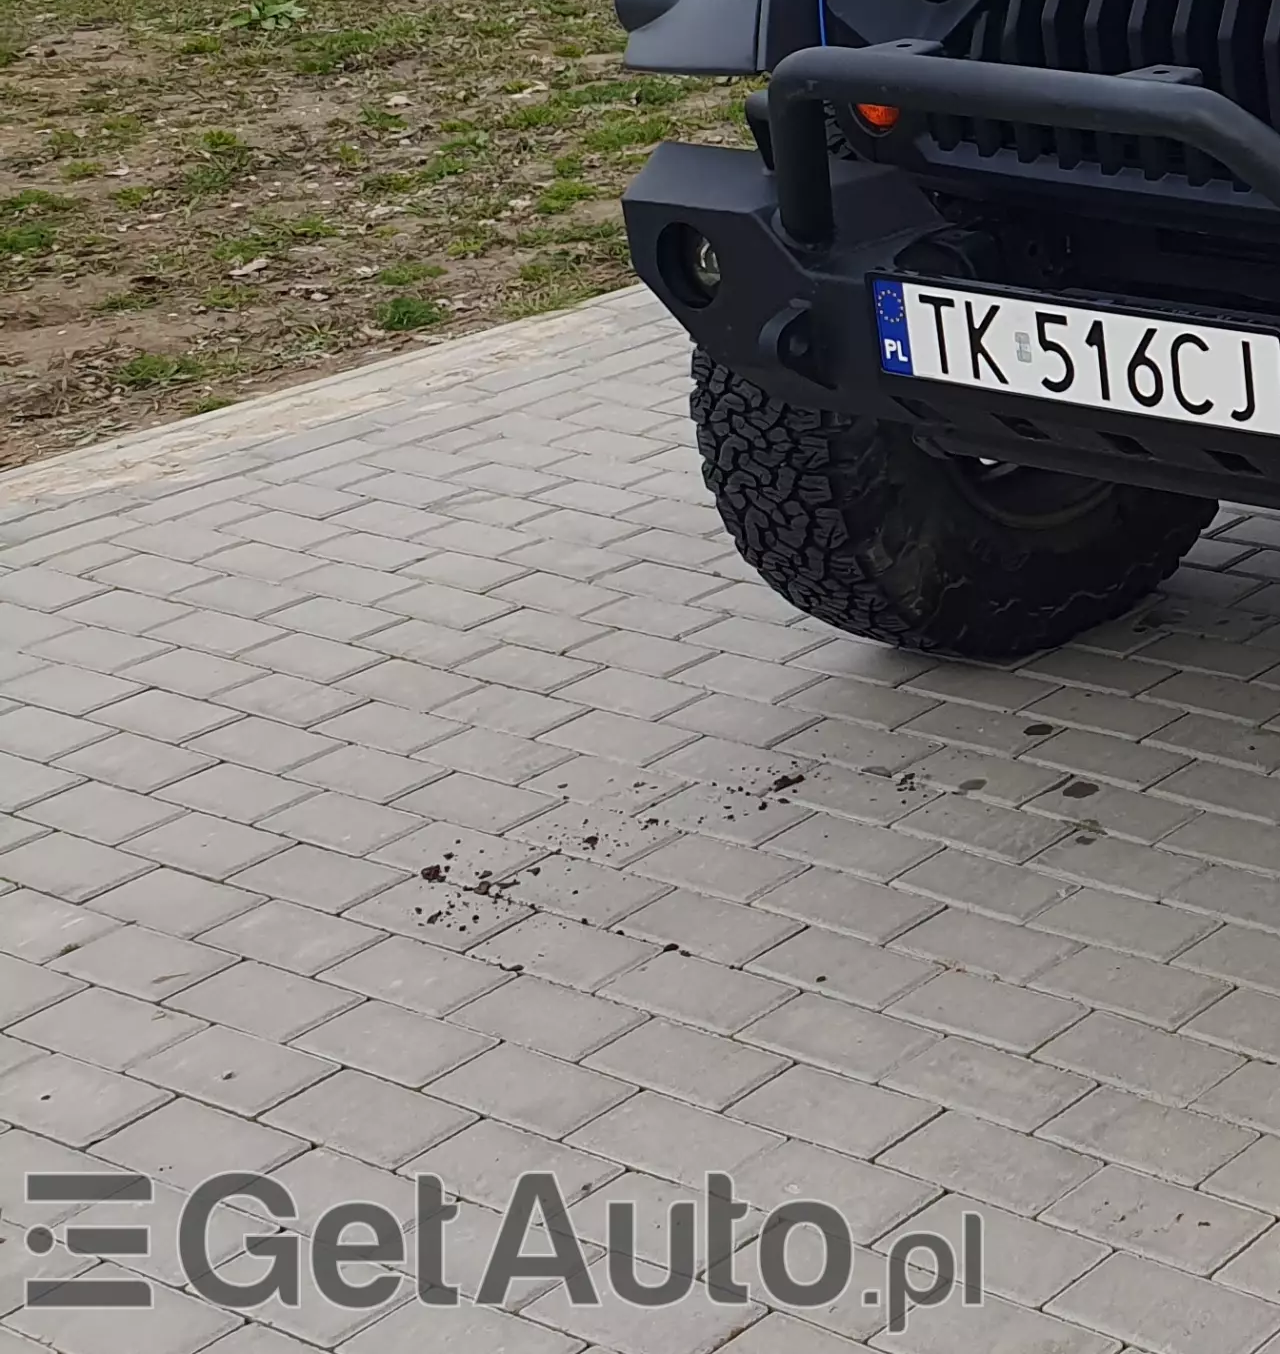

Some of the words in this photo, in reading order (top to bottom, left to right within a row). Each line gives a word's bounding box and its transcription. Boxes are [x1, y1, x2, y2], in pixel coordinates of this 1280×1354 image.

[884, 338, 908, 362] PL
[918, 294, 1009, 385] TK
[1035, 311, 1256, 422] 516CJ
